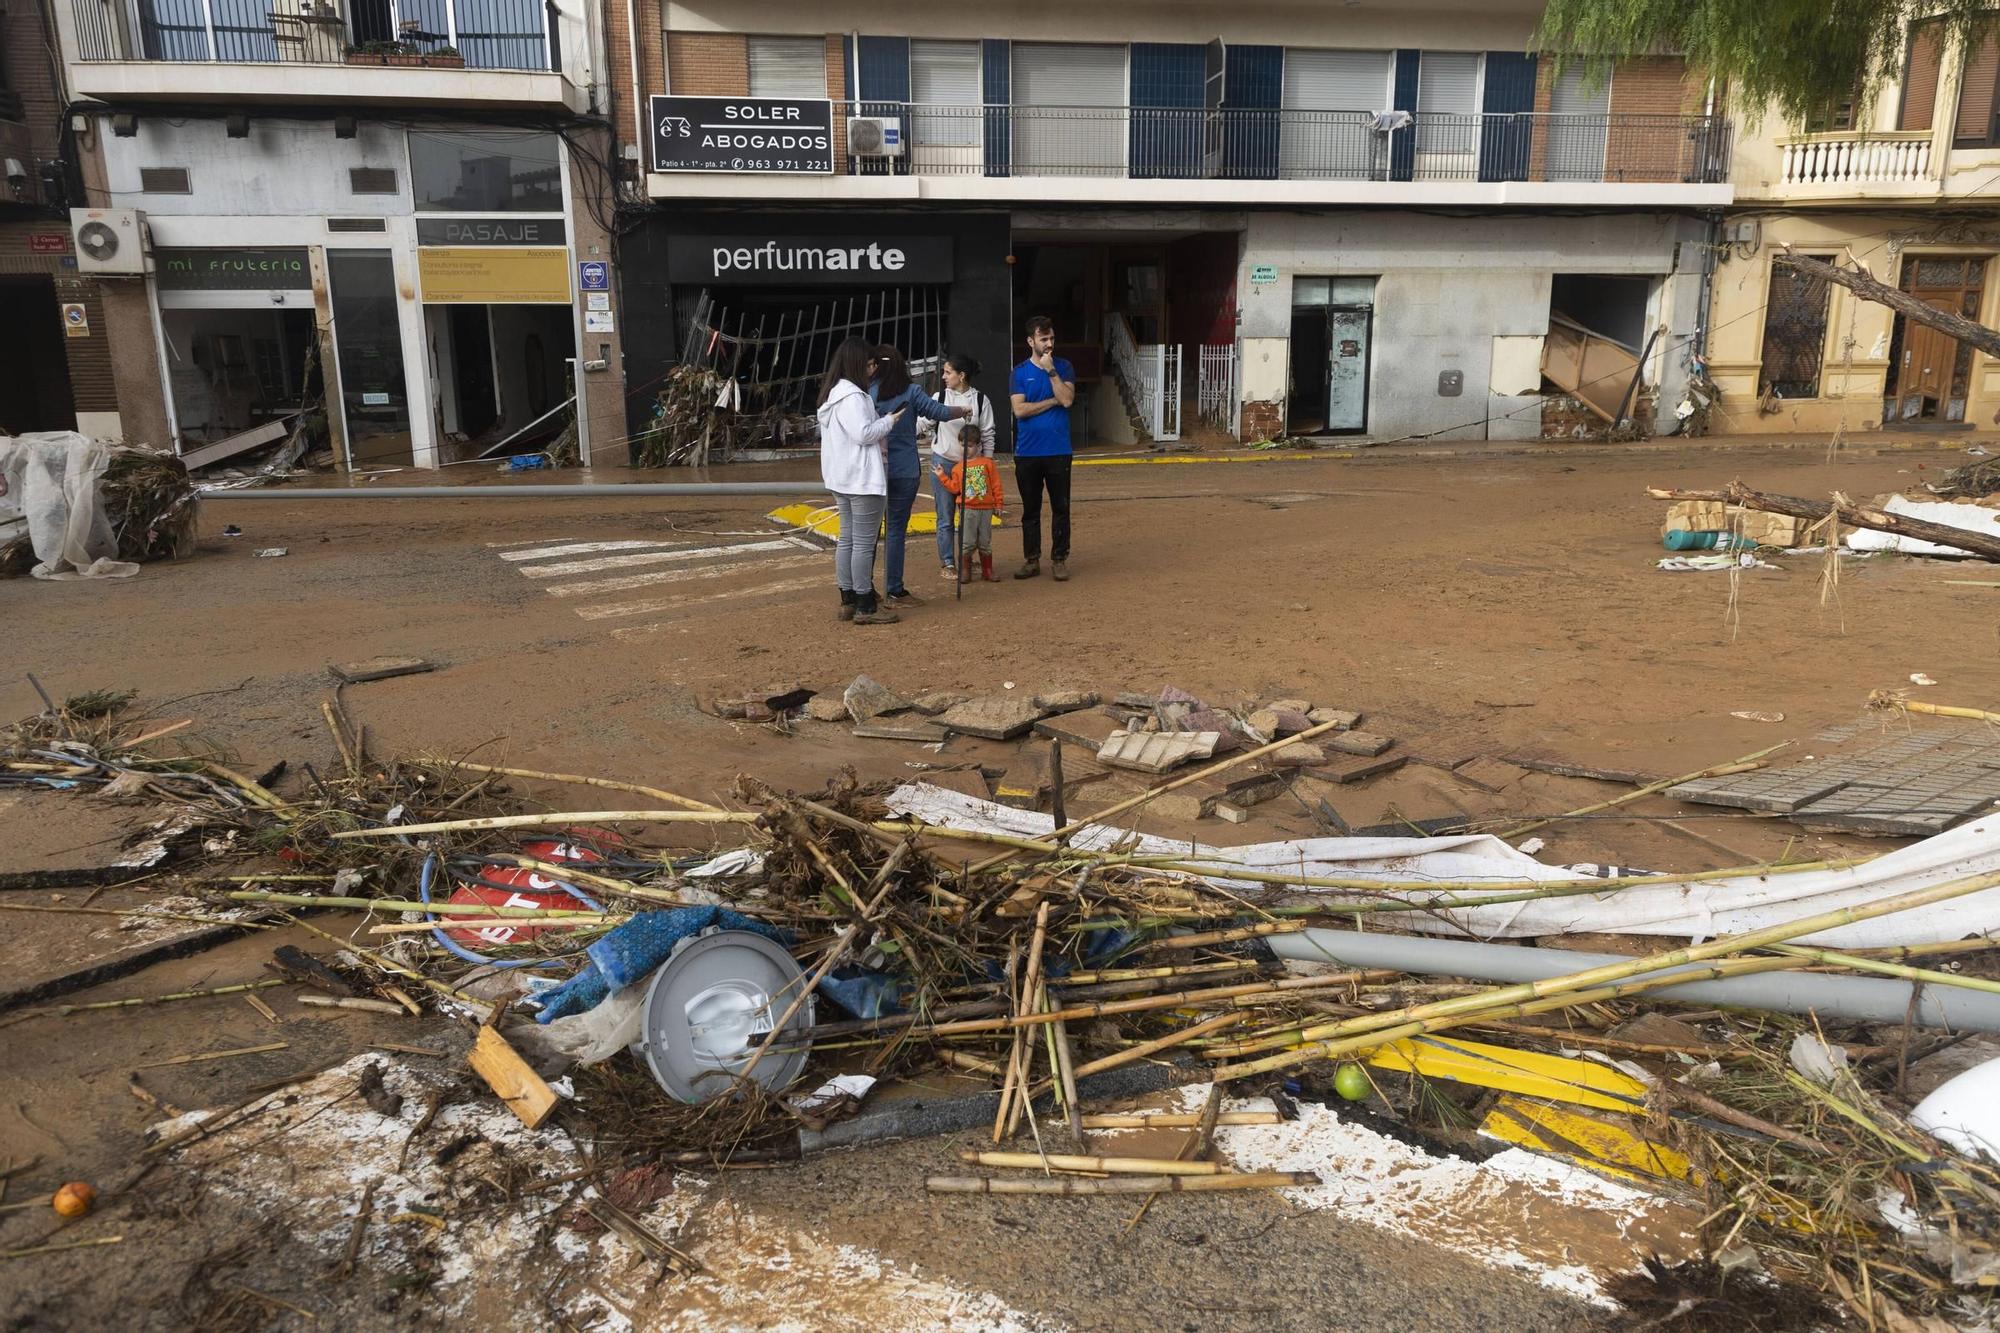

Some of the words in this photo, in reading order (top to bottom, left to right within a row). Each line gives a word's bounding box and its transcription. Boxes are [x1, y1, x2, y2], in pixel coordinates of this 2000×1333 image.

[725, 106, 800, 120] SOLER
[701, 135, 828, 149] ABOGADOS
[748, 160, 771, 169] 963
[777, 160, 800, 169] 971
[806, 161, 829, 170] 221
[446, 224, 539, 241] PASAJE
[168, 258, 192, 270] mi
[713, 241, 906, 277] perfumarte
